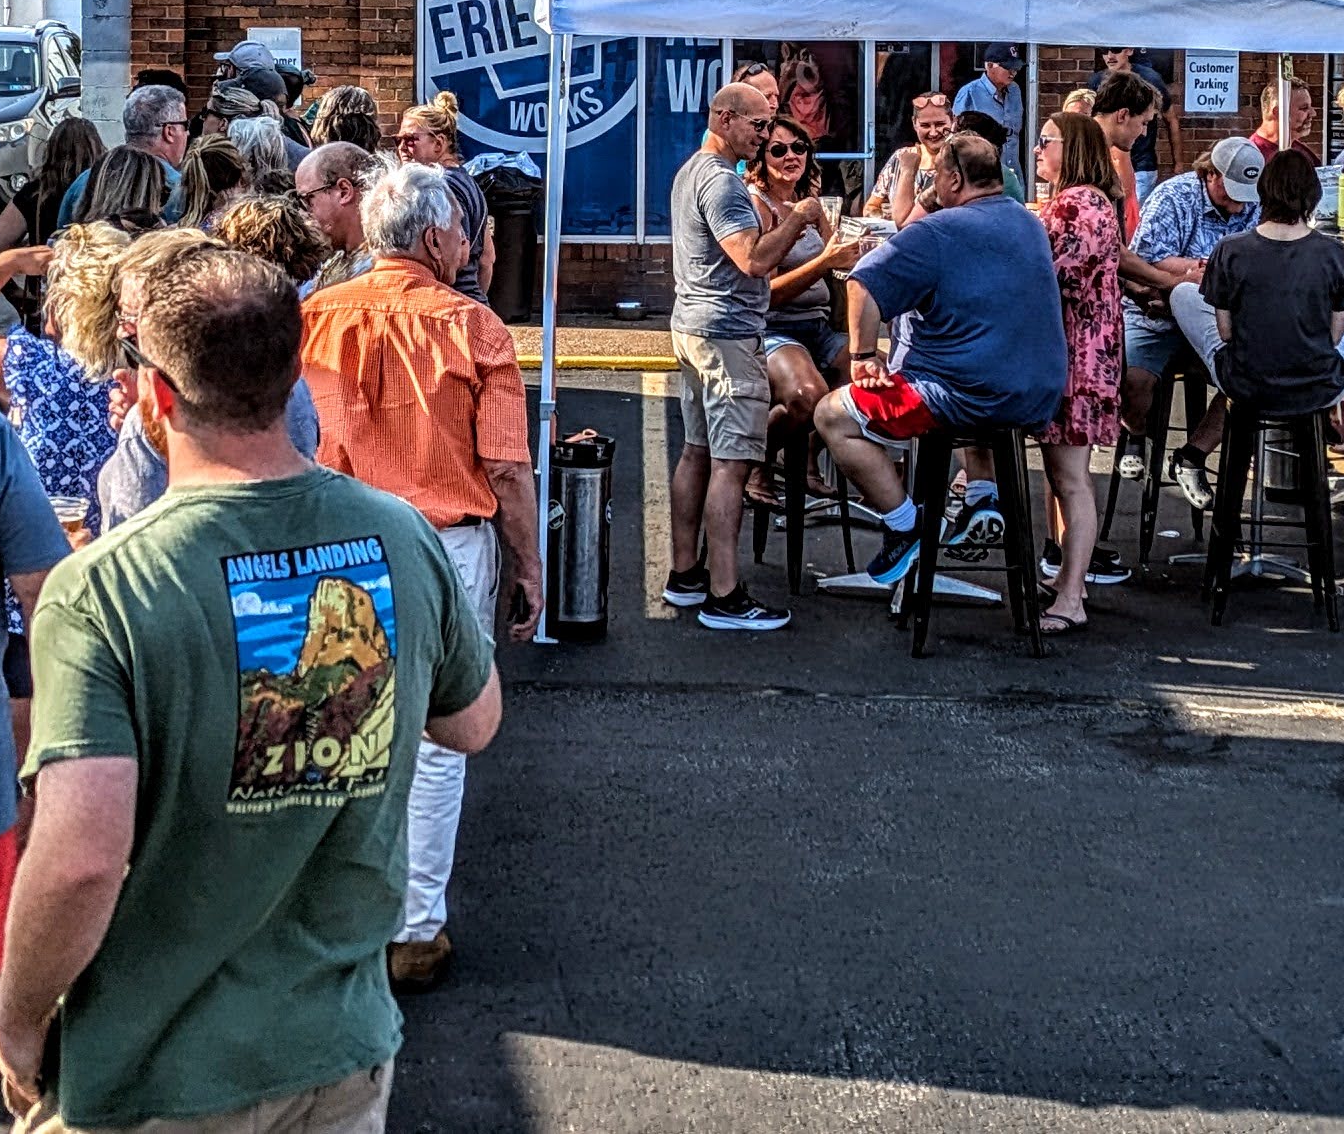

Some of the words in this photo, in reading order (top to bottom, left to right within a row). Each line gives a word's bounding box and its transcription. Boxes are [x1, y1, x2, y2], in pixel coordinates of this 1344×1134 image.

[1189, 62, 1234, 74] Customer
[1194, 78, 1229, 92] Parking
[510, 86, 604, 132] WOKS
[1197, 94, 1226, 109] Only
[226, 552, 291, 583] ANGELS
[294, 537, 383, 575] LANDING
[262, 733, 378, 776] ZION
